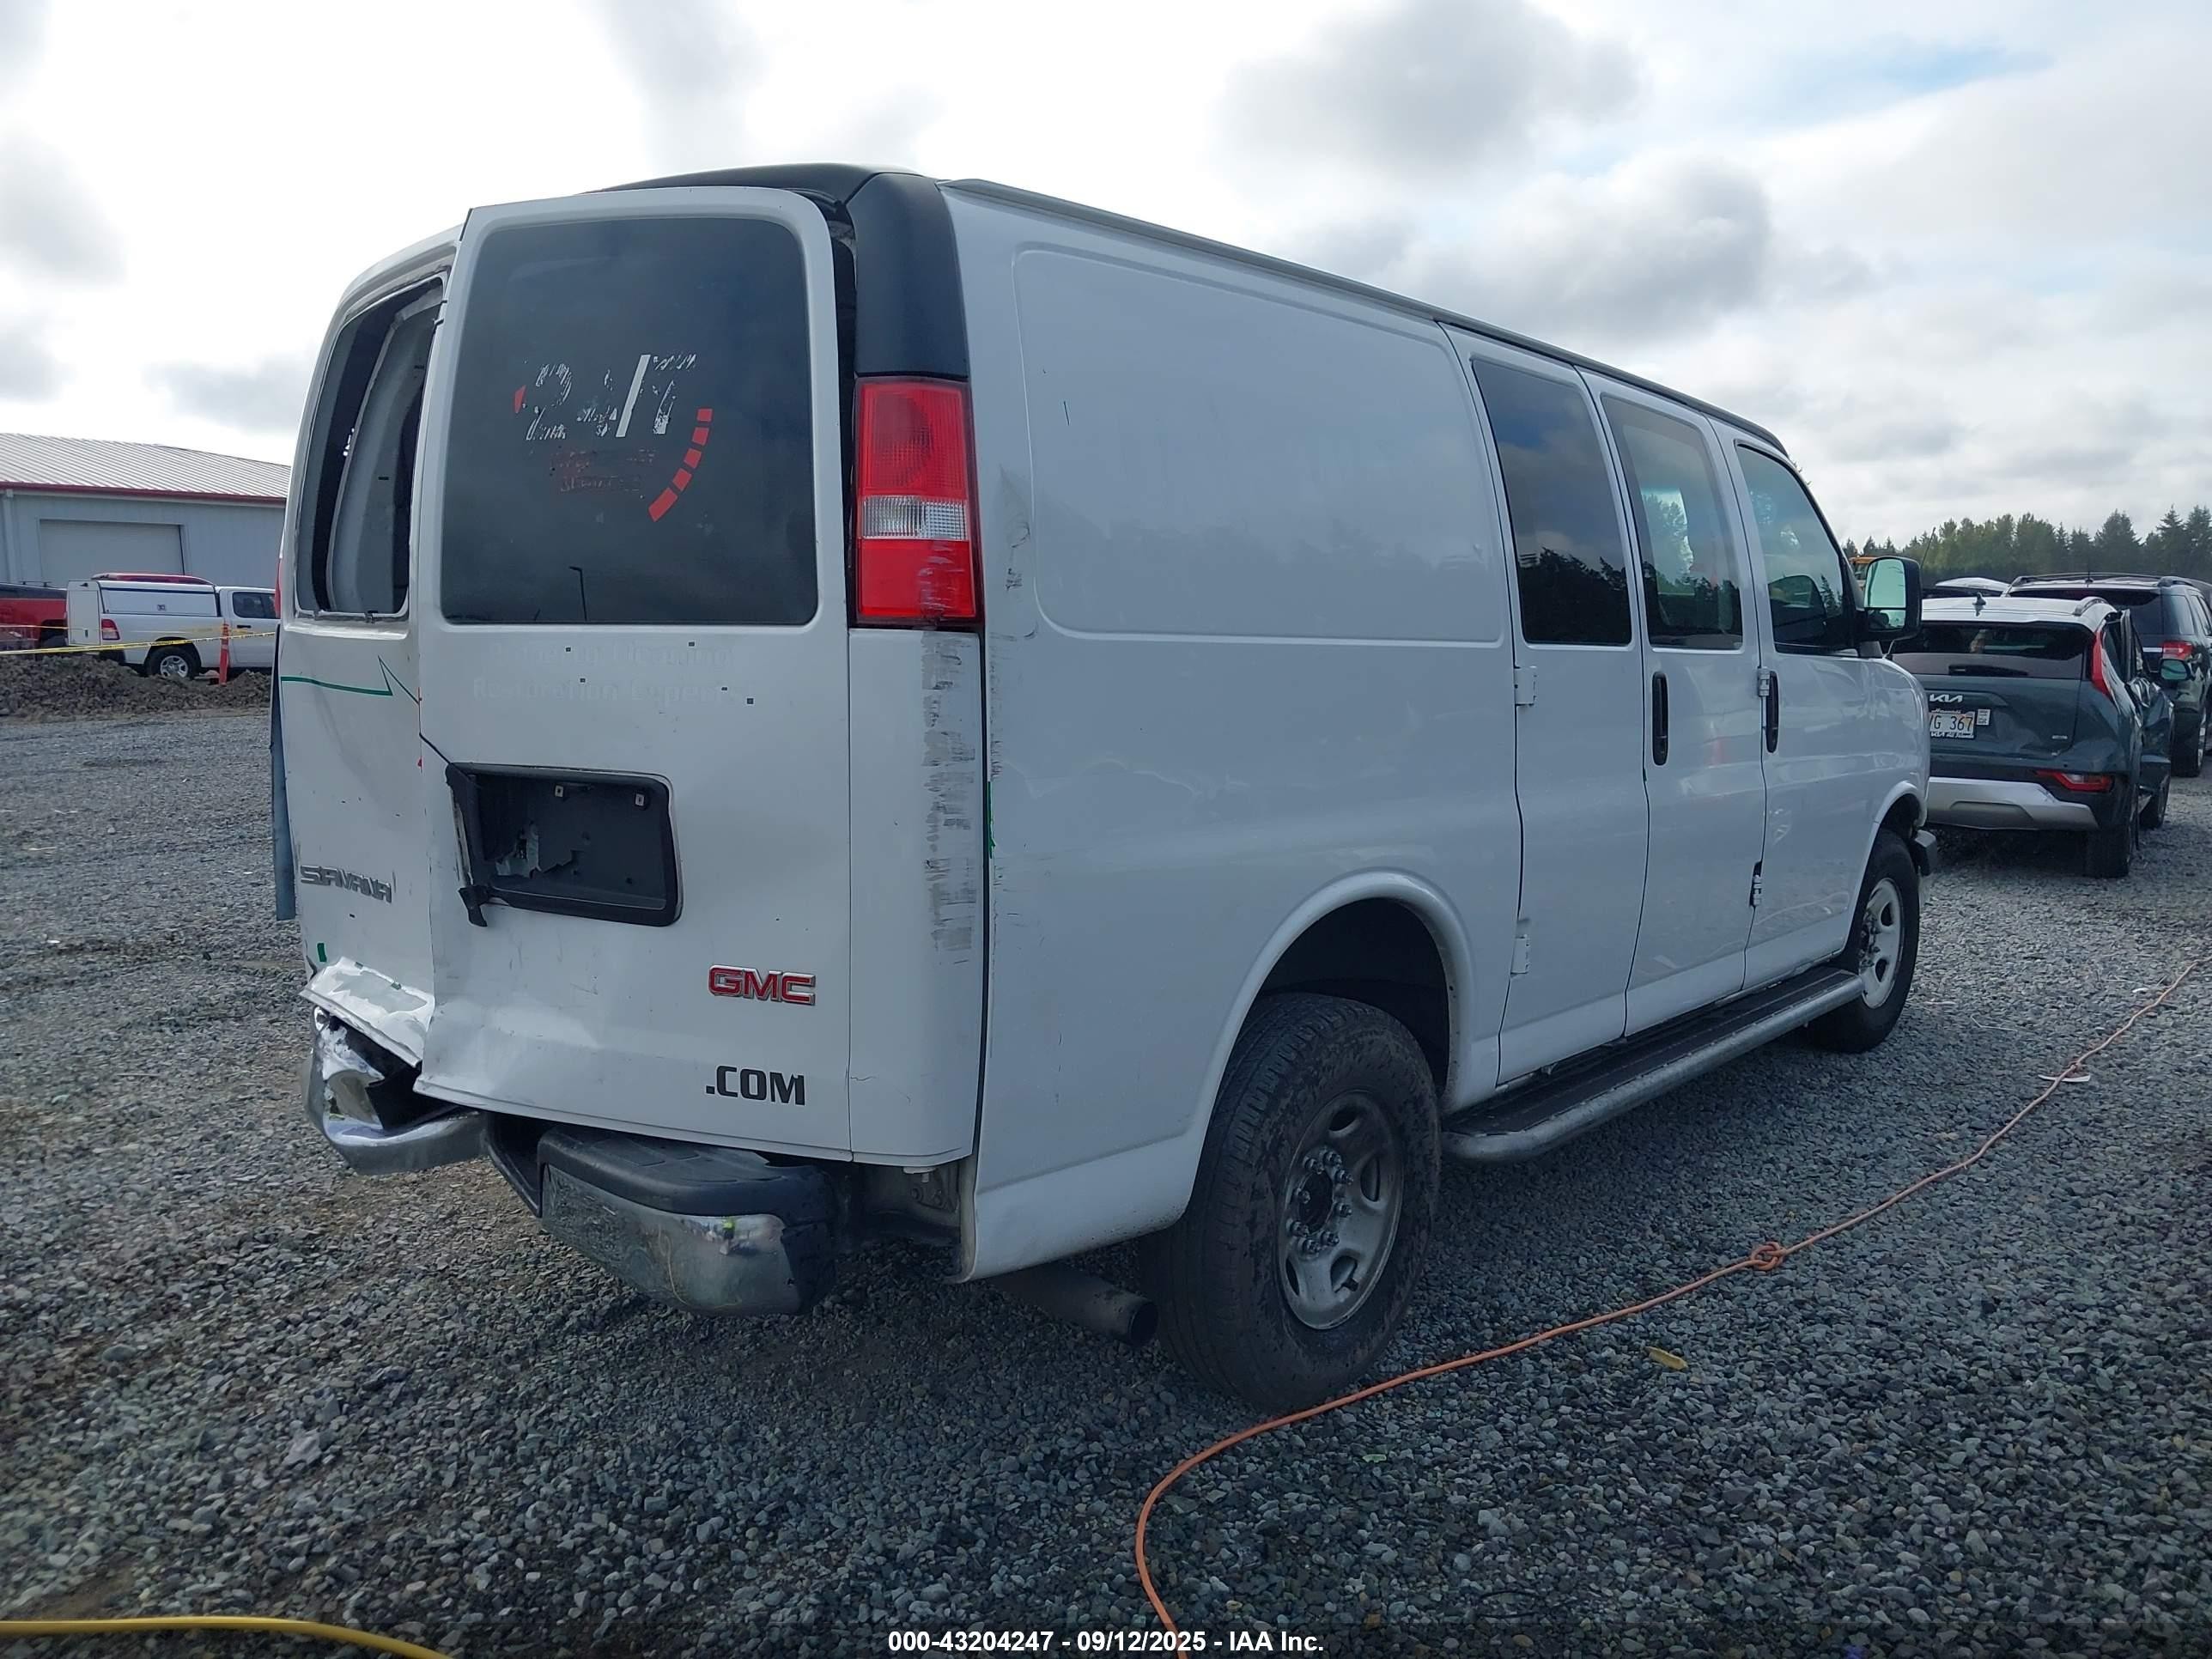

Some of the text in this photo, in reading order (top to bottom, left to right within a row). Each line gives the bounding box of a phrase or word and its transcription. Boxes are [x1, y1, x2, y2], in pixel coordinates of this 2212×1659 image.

[1949, 715, 1973, 732] 367
[300, 864, 392, 904] SAVANA
[708, 964, 816, 1006] GMC
[705, 1065, 805, 1106] .COM
